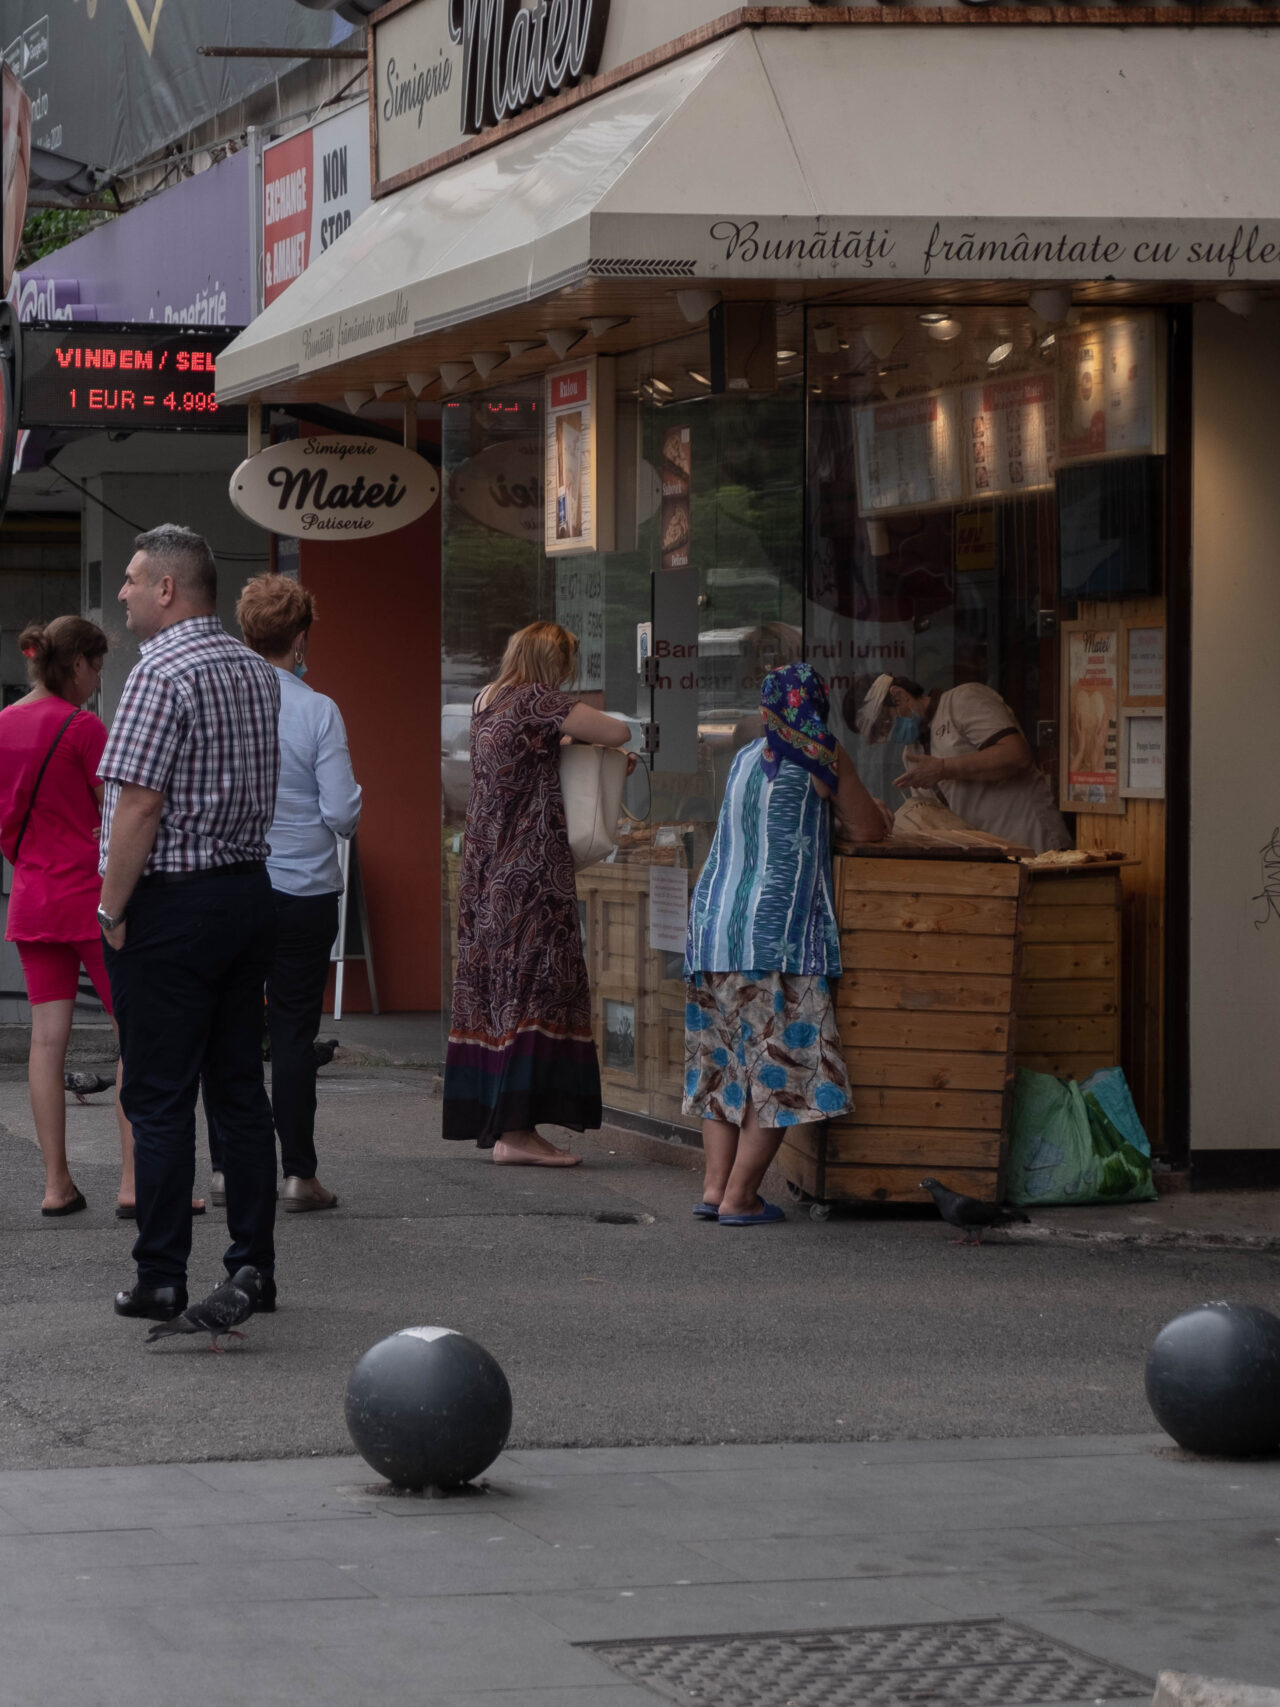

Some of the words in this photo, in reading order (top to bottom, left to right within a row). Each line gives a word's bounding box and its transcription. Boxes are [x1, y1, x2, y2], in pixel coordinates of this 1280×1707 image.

[383, 48, 453, 128] Simigerie
[448, 0, 595, 134] Matei
[265, 167, 307, 226] EXCHANGE
[323, 145, 348, 203] NON
[273, 231, 306, 285] AMANET
[1134, 242, 1180, 263] cu
[1187, 224, 1280, 278] sufle
[55, 348, 153, 370] VINDEM
[176, 350, 217, 372] SEL
[70, 388, 77, 409] 1
[89, 389, 135, 410] EUR
[303, 435, 377, 460] Simigerie
[267, 466, 407, 510] Matei
[301, 513, 375, 530] Patiserie
[850, 640, 905, 658] lumii
